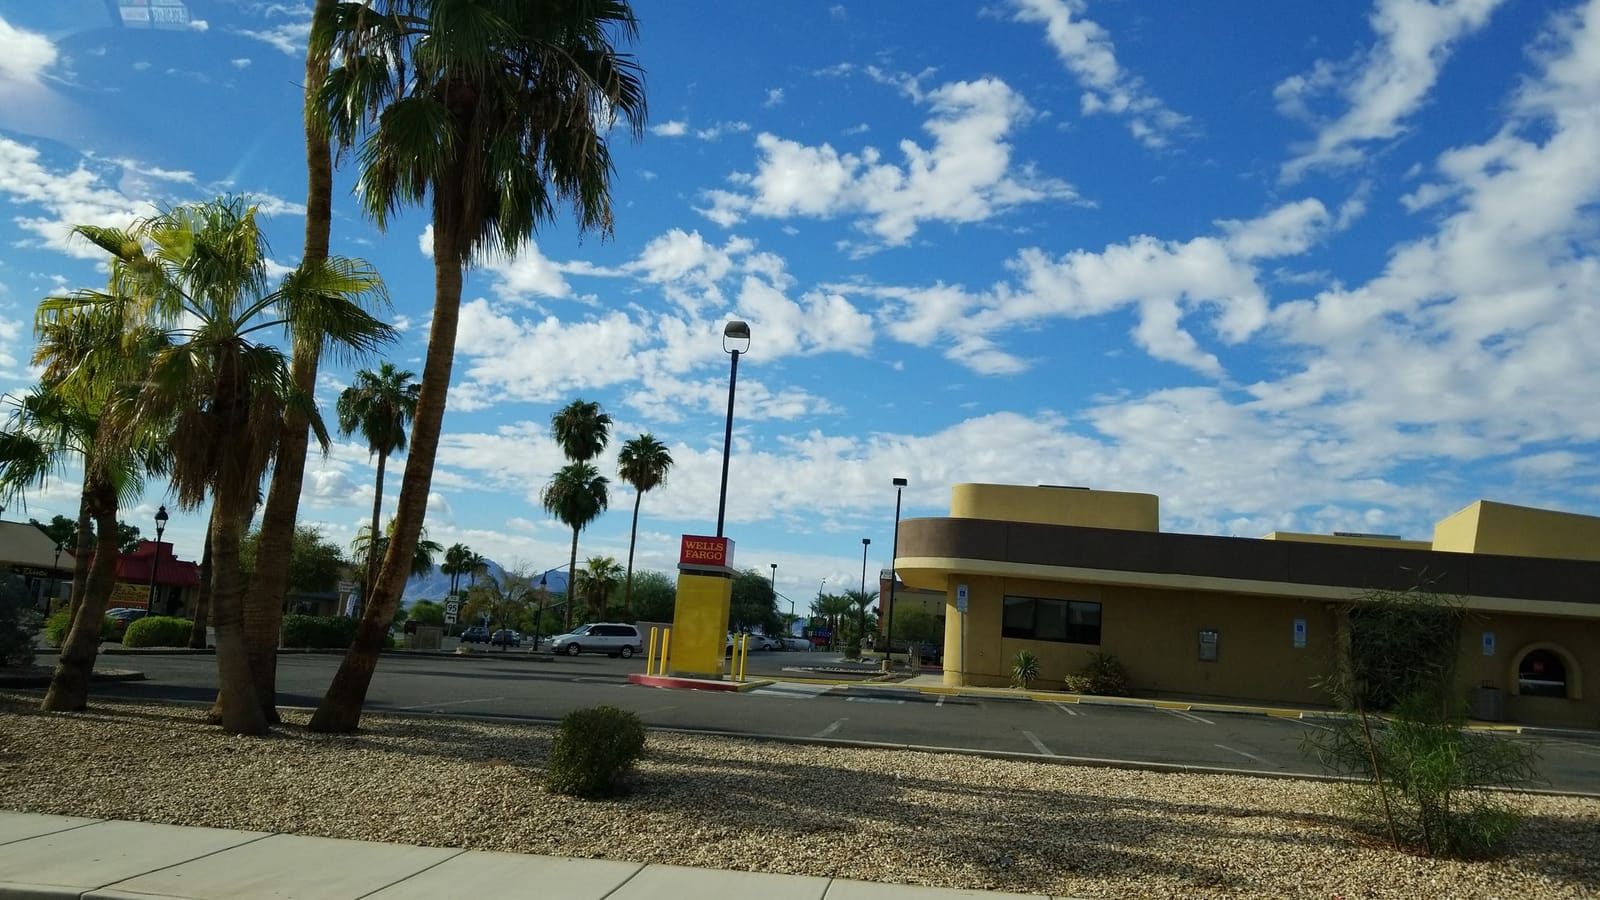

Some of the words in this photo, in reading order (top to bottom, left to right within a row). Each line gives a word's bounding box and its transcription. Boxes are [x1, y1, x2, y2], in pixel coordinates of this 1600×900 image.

[685, 541, 724, 552] WELLS
[685, 551, 722, 560] FARGO
[448, 604, 457, 612] 95
